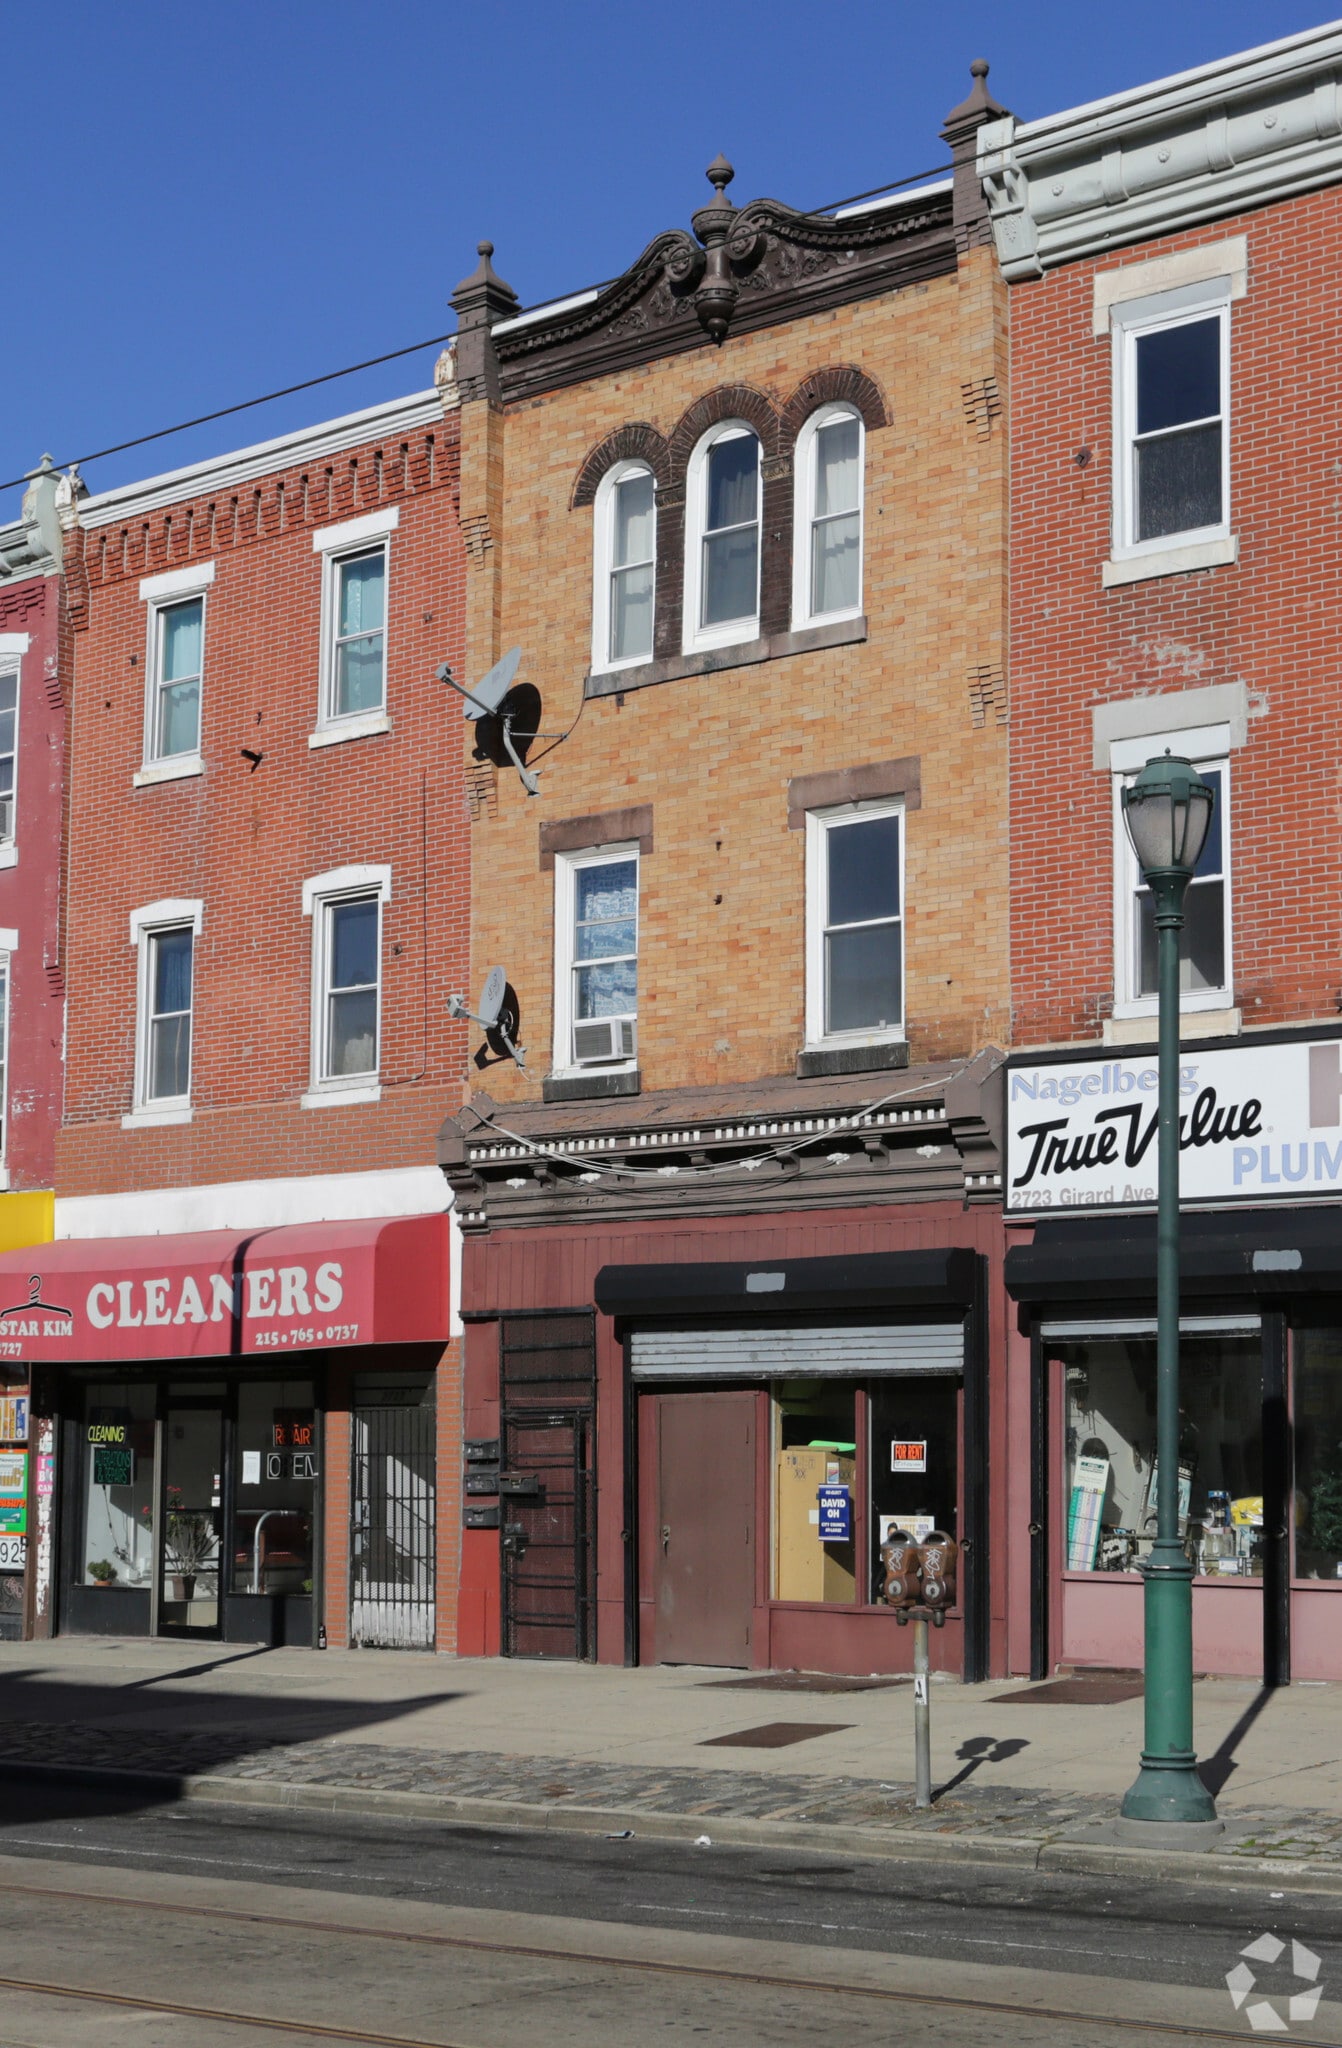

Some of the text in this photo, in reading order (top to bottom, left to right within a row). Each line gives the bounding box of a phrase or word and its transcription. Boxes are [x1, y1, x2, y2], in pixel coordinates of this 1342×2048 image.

[1011, 1064, 1199, 1106] Nagelbeg
[1011, 1190, 1051, 1208] 2723
[1059, 1185, 1114, 1205] Girard
[87, 1262, 343, 1329] CLEANERS
[43, 1320, 73, 1336] KIM
[88, 1426, 125, 1442] CLEANING
[895, 1444, 923, 1460] FOR RENT
[270, 1455, 315, 1477] OEN
[821, 1498, 846, 1508] DAVID
[827, 1509, 840, 1518] OH
